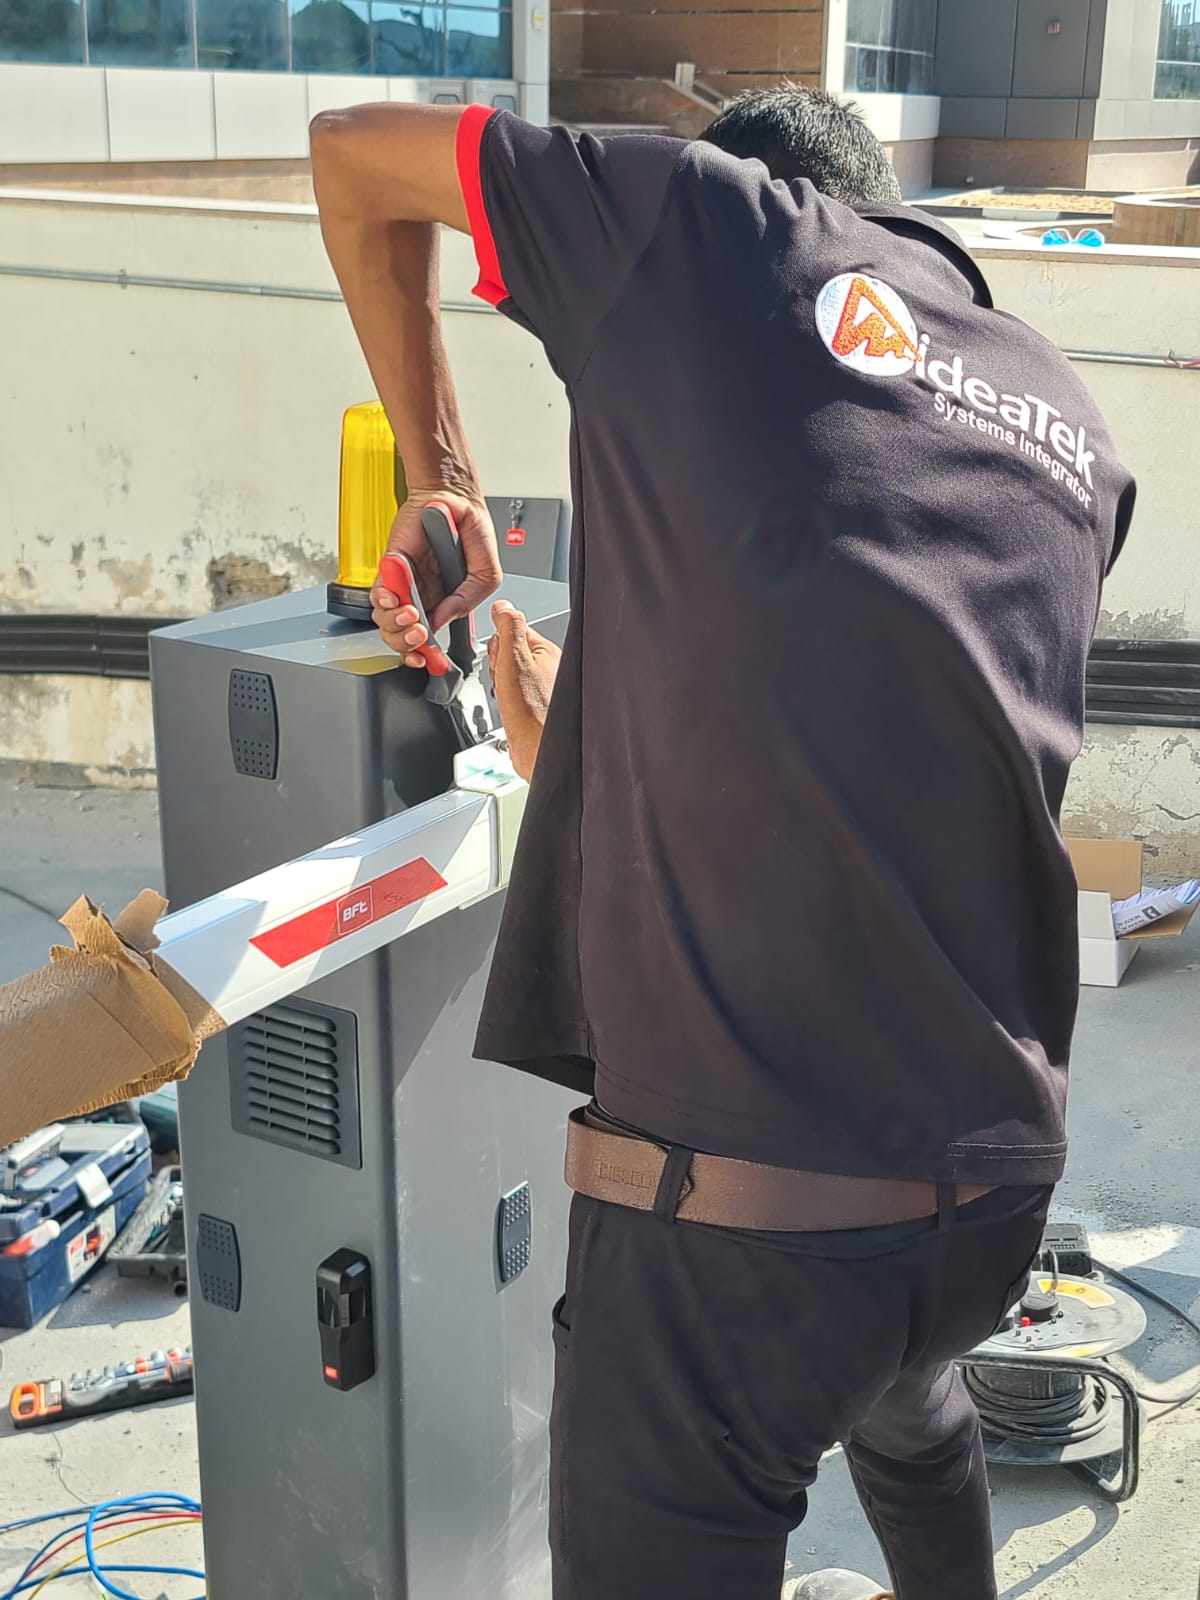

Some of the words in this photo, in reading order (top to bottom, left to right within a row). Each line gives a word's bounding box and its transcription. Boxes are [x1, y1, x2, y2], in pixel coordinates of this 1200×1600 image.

[914, 333, 1095, 490] ideaTek
[934, 391, 1017, 444] Systems
[1018, 432, 1092, 509] Integrator
